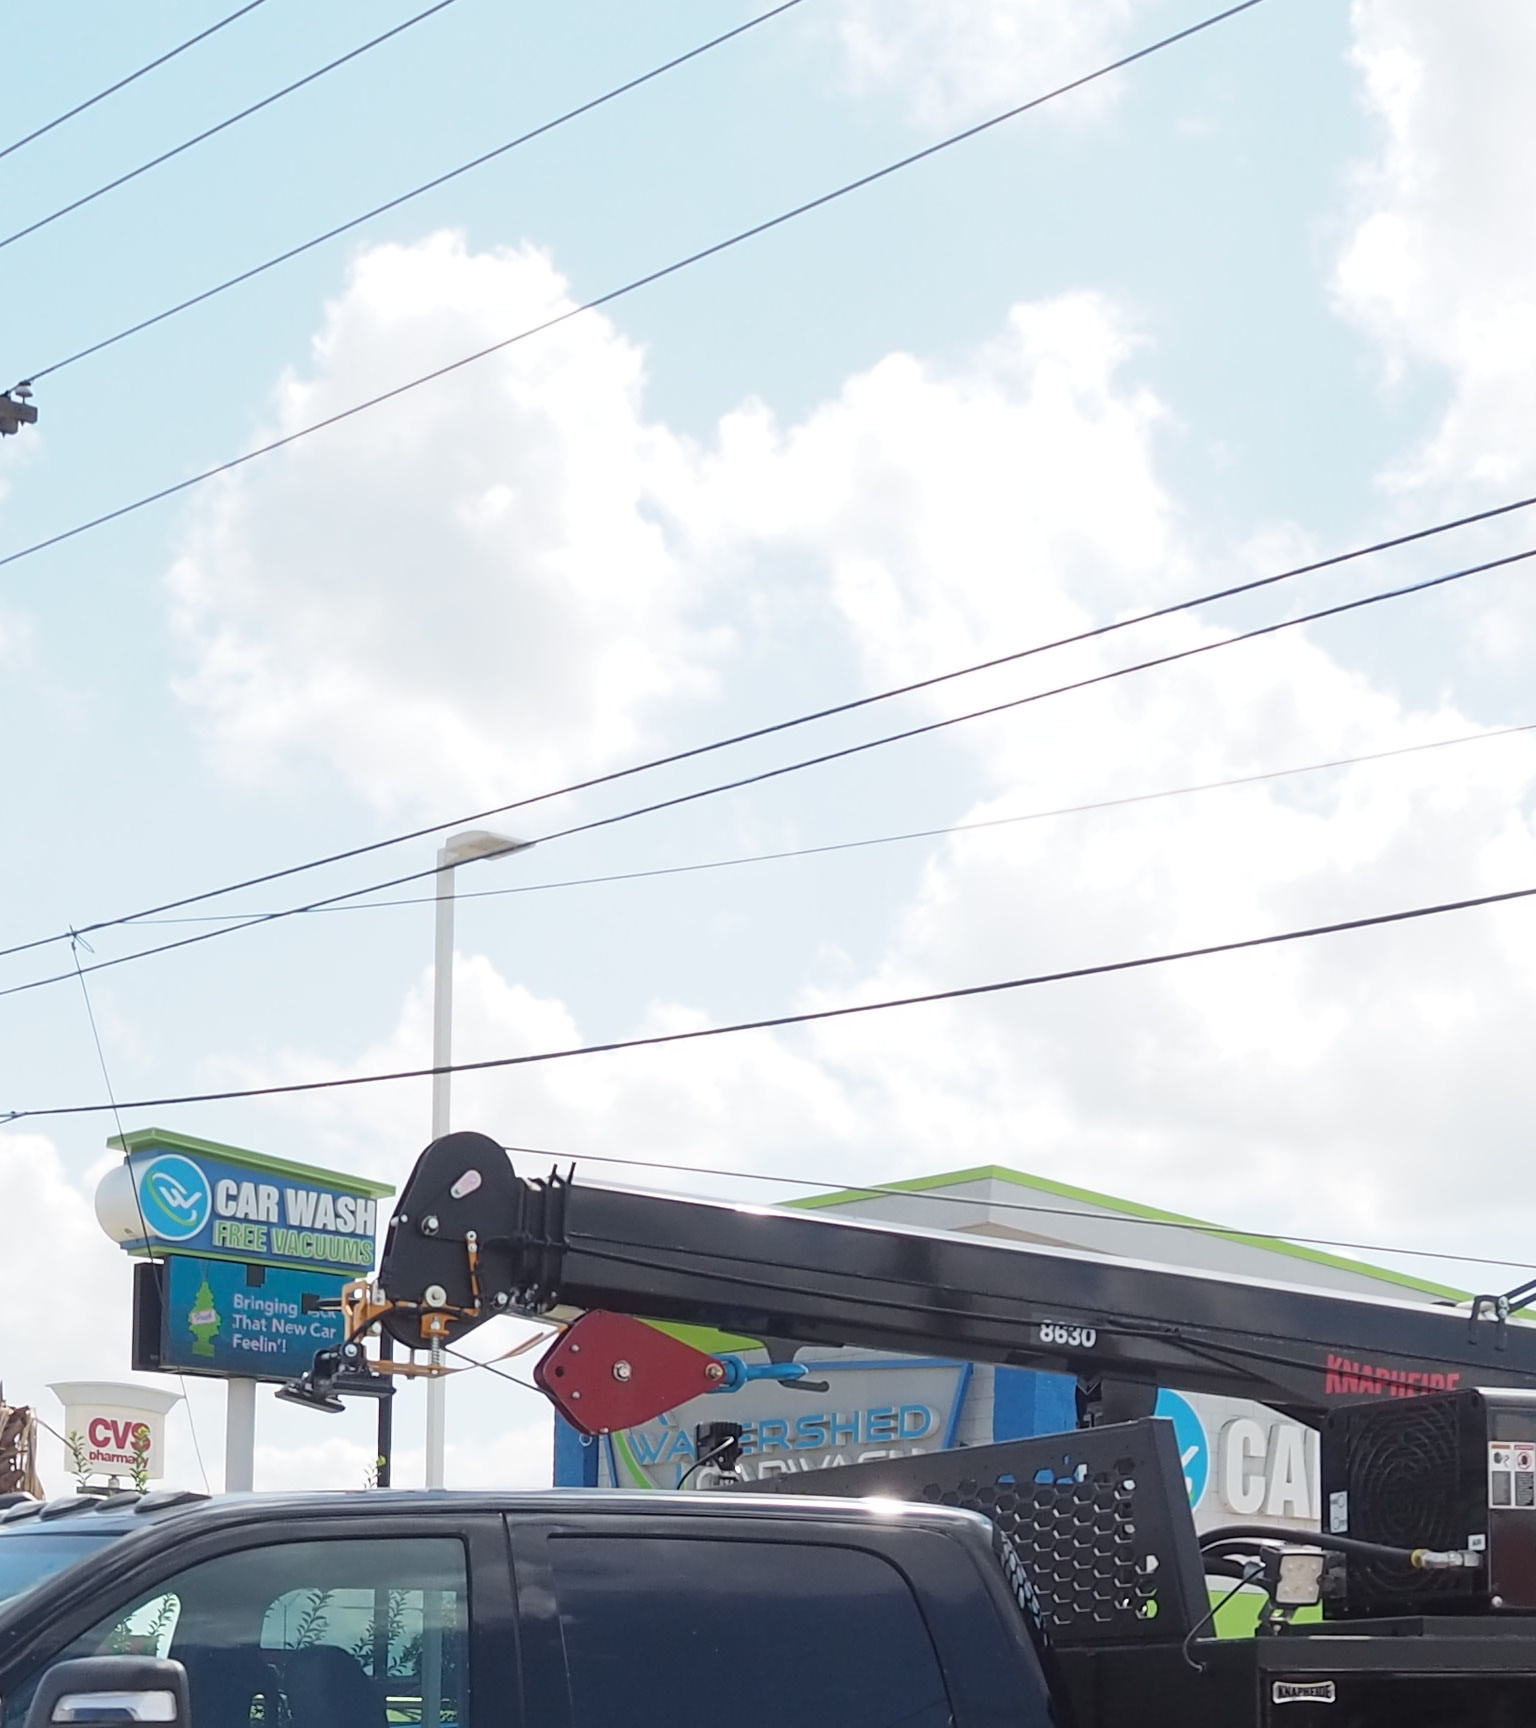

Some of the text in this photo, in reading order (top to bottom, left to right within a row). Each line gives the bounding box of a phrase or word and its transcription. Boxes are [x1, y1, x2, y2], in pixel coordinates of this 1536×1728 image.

[215, 1179, 377, 1236] CAR WASH
[213, 1219, 374, 1266] FREE VACUUMS
[233, 1293, 298, 1318] Bringing
[232, 1314, 267, 1332] That
[272, 1318, 307, 1336] New
[310, 1322, 337, 1339] Car
[1039, 1319, 1097, 1348] 8630
[232, 1333, 287, 1353] Feelin'!
[88, 1417, 151, 1452] CVS
[628, 1404, 934, 1465] WAERSHED
